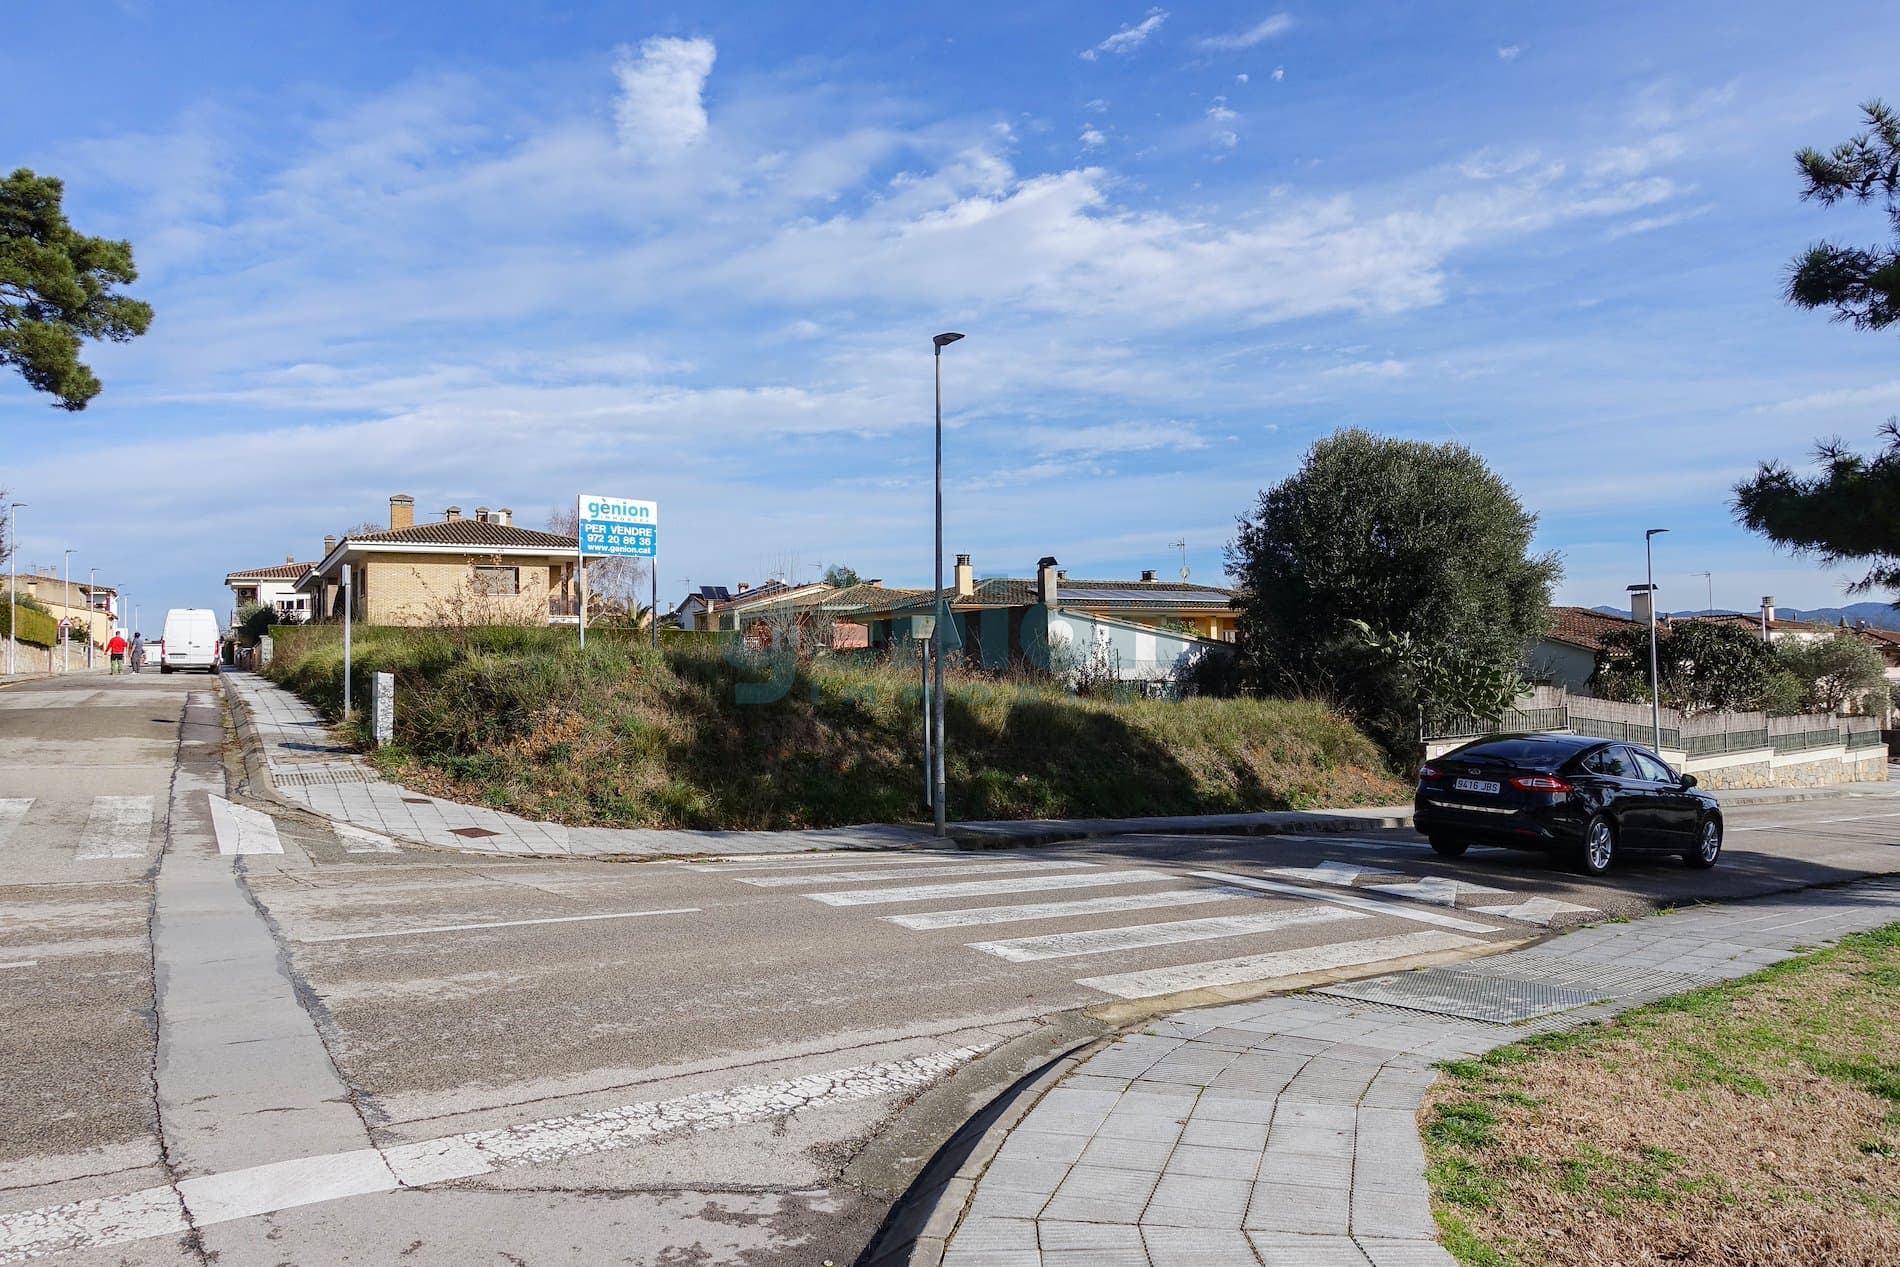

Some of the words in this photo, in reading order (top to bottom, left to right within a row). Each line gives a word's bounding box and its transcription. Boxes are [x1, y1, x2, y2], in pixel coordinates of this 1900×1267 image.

[588, 498, 649, 518] gènion
[585, 523, 606, 534] PER
[610, 525, 653, 537] VENDRE
[587, 533, 604, 543] 972
[607, 535, 620, 544] 20
[639, 537, 651, 546] 36
[587, 544, 651, 554] www.genion.cat
[1457, 780, 1479, 789] 9416
[1480, 782, 1498, 792] JBS
